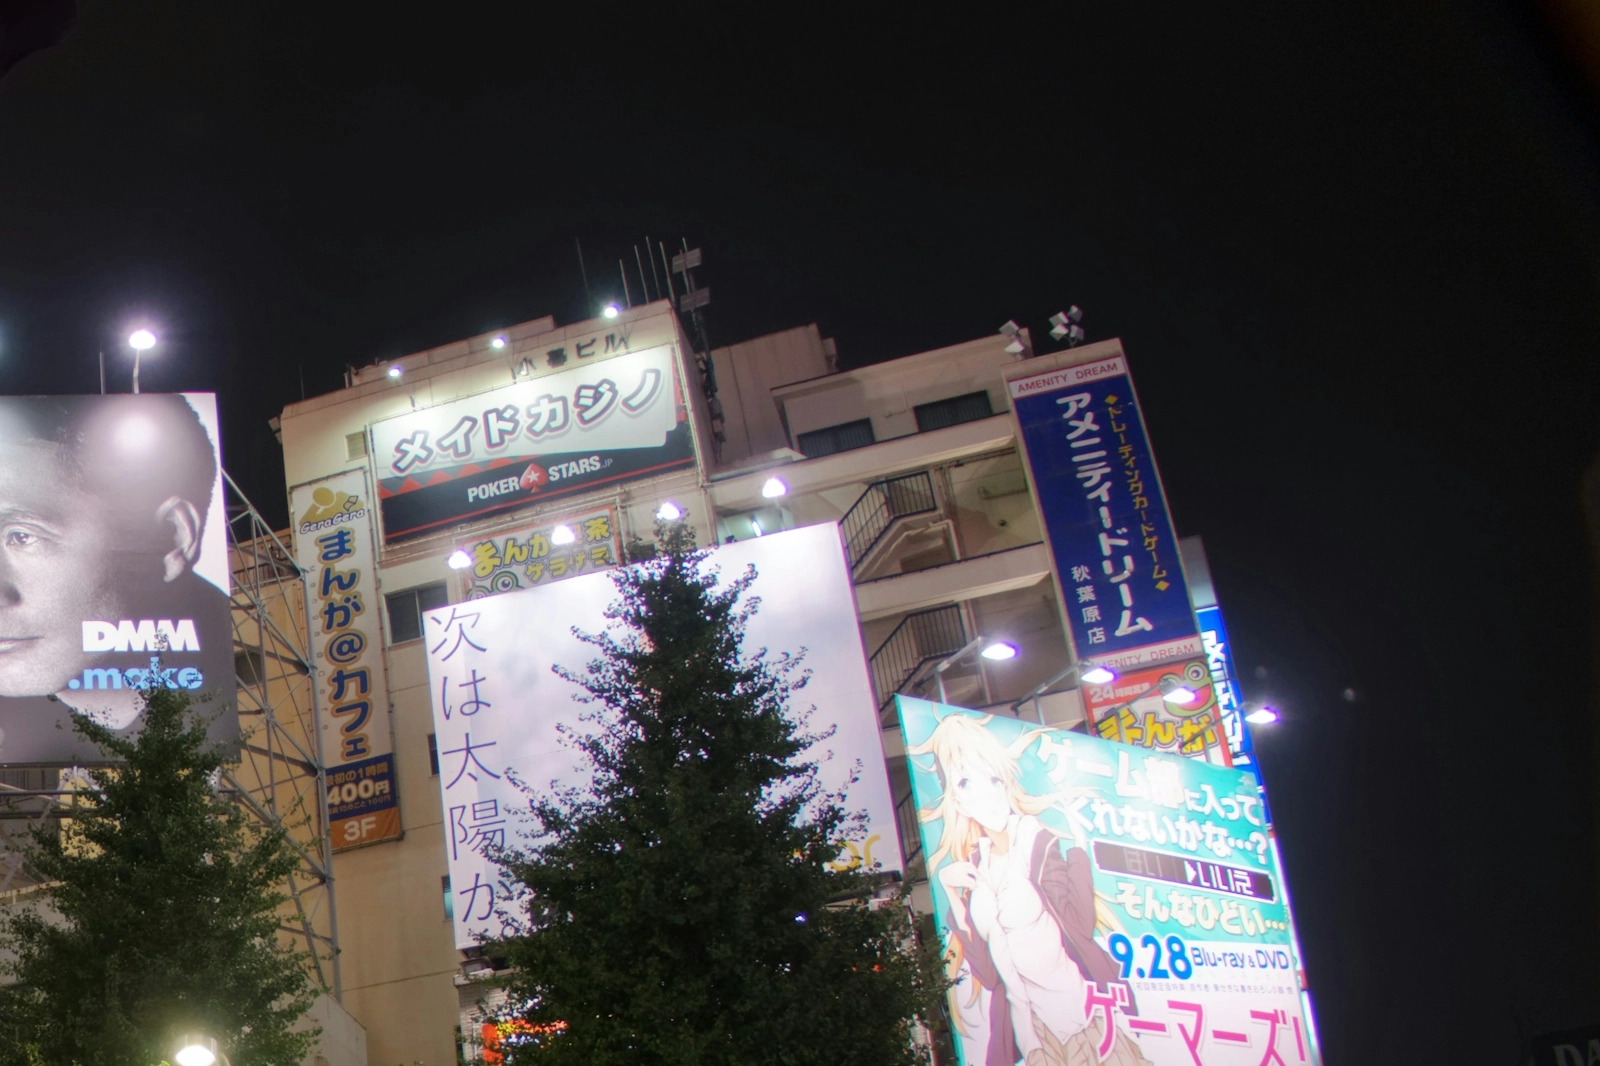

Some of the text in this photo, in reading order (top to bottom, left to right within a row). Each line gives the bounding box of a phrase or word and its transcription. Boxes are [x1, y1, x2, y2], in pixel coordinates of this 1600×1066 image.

[1017, 362, 1118, 393] AMENITY DREAM
[391, 367, 662, 476] メイドカジノ
[467, 477, 519, 502] POKER
[299, 508, 365, 534] GeraGera
[1057, 391, 1153, 637] アメニティードリーム
[1071, 565, 1106, 645] 秋葉原店
[82, 619, 200, 651] DMM
[318, 528, 372, 761] まんが@カフェ
[1150, 643, 1194, 661] DREAM
[328, 778, 390, 805] 400円
[344, 816, 376, 840] 3F
[1108, 933, 1193, 980] 9.28
[1191, 947, 1245, 968] Blu-ray
[1256, 949, 1290, 970] DVD
